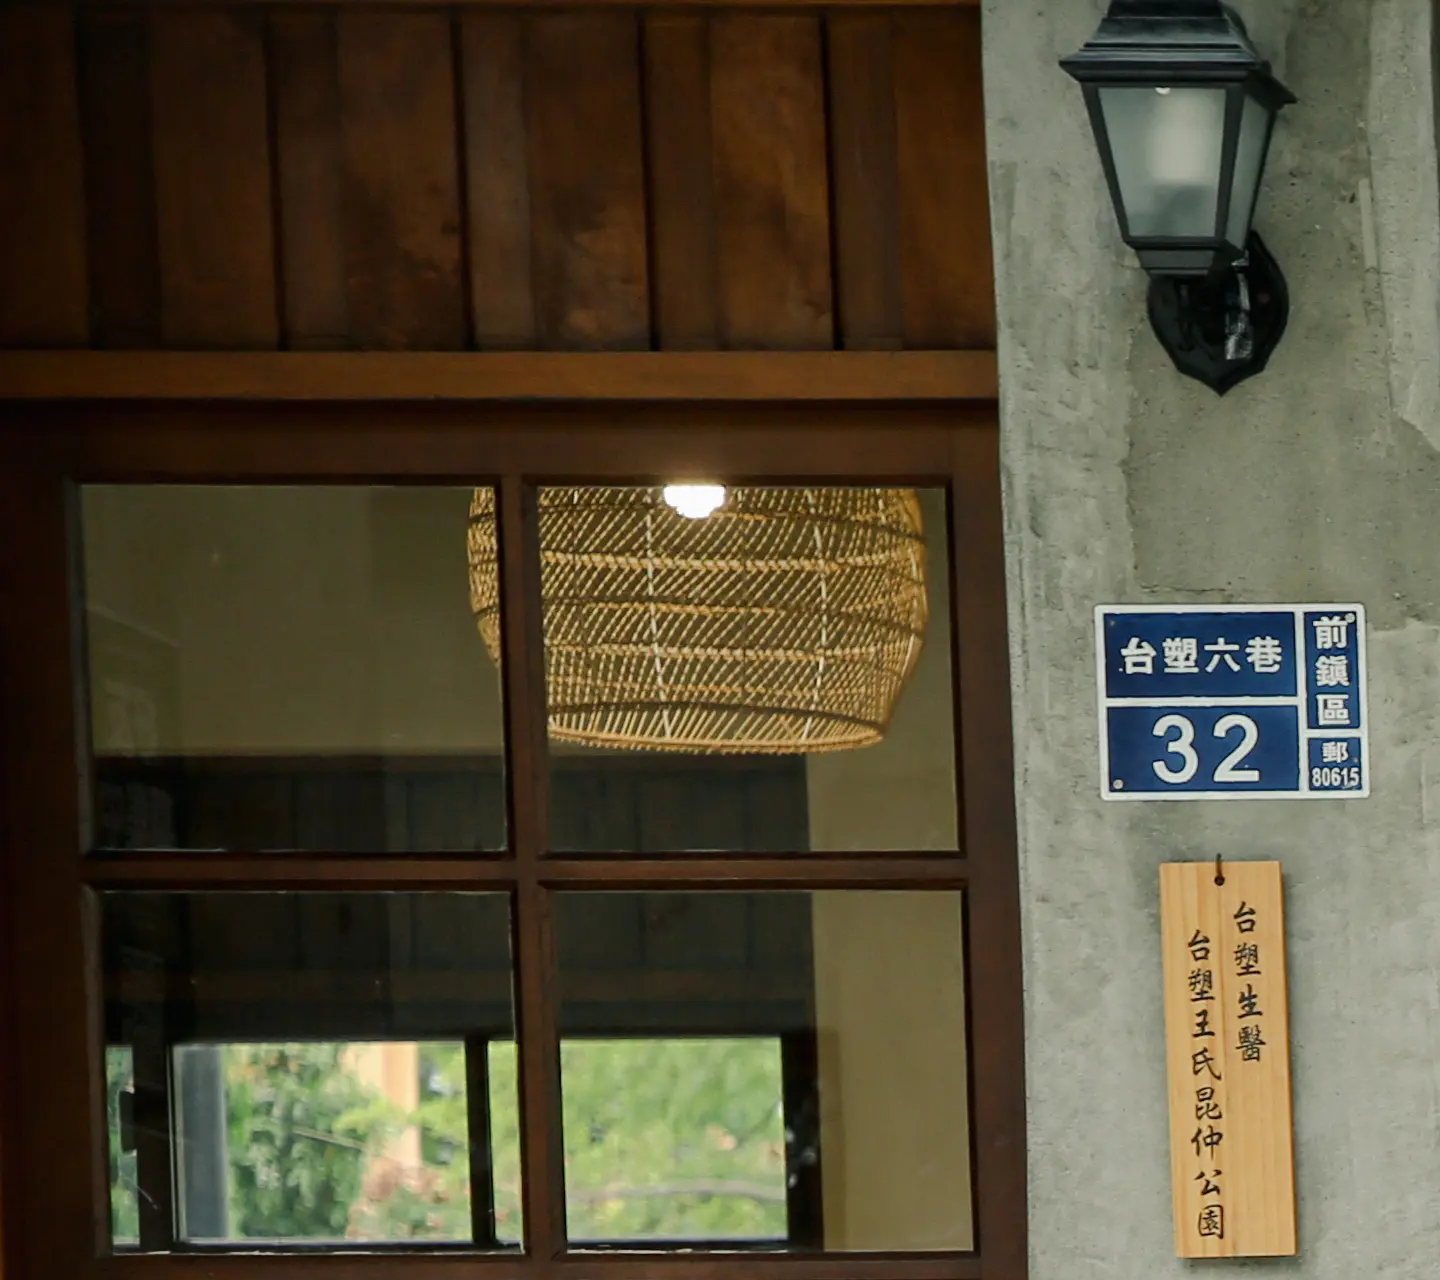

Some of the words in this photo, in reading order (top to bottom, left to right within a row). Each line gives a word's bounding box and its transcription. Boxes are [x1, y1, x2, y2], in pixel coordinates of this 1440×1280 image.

[1120, 636, 1283, 675] 台塑六巷
[1313, 614, 1352, 727] 前鎮區
[1151, 713, 1260, 784] 32
[1311, 765, 1360, 789] 80615
[1322, 741, 1350, 764] 郵
[1233, 900, 1266, 1062] 台塑生醫
[1187, 929, 1224, 1240] 台塑王氏昆仲公園
